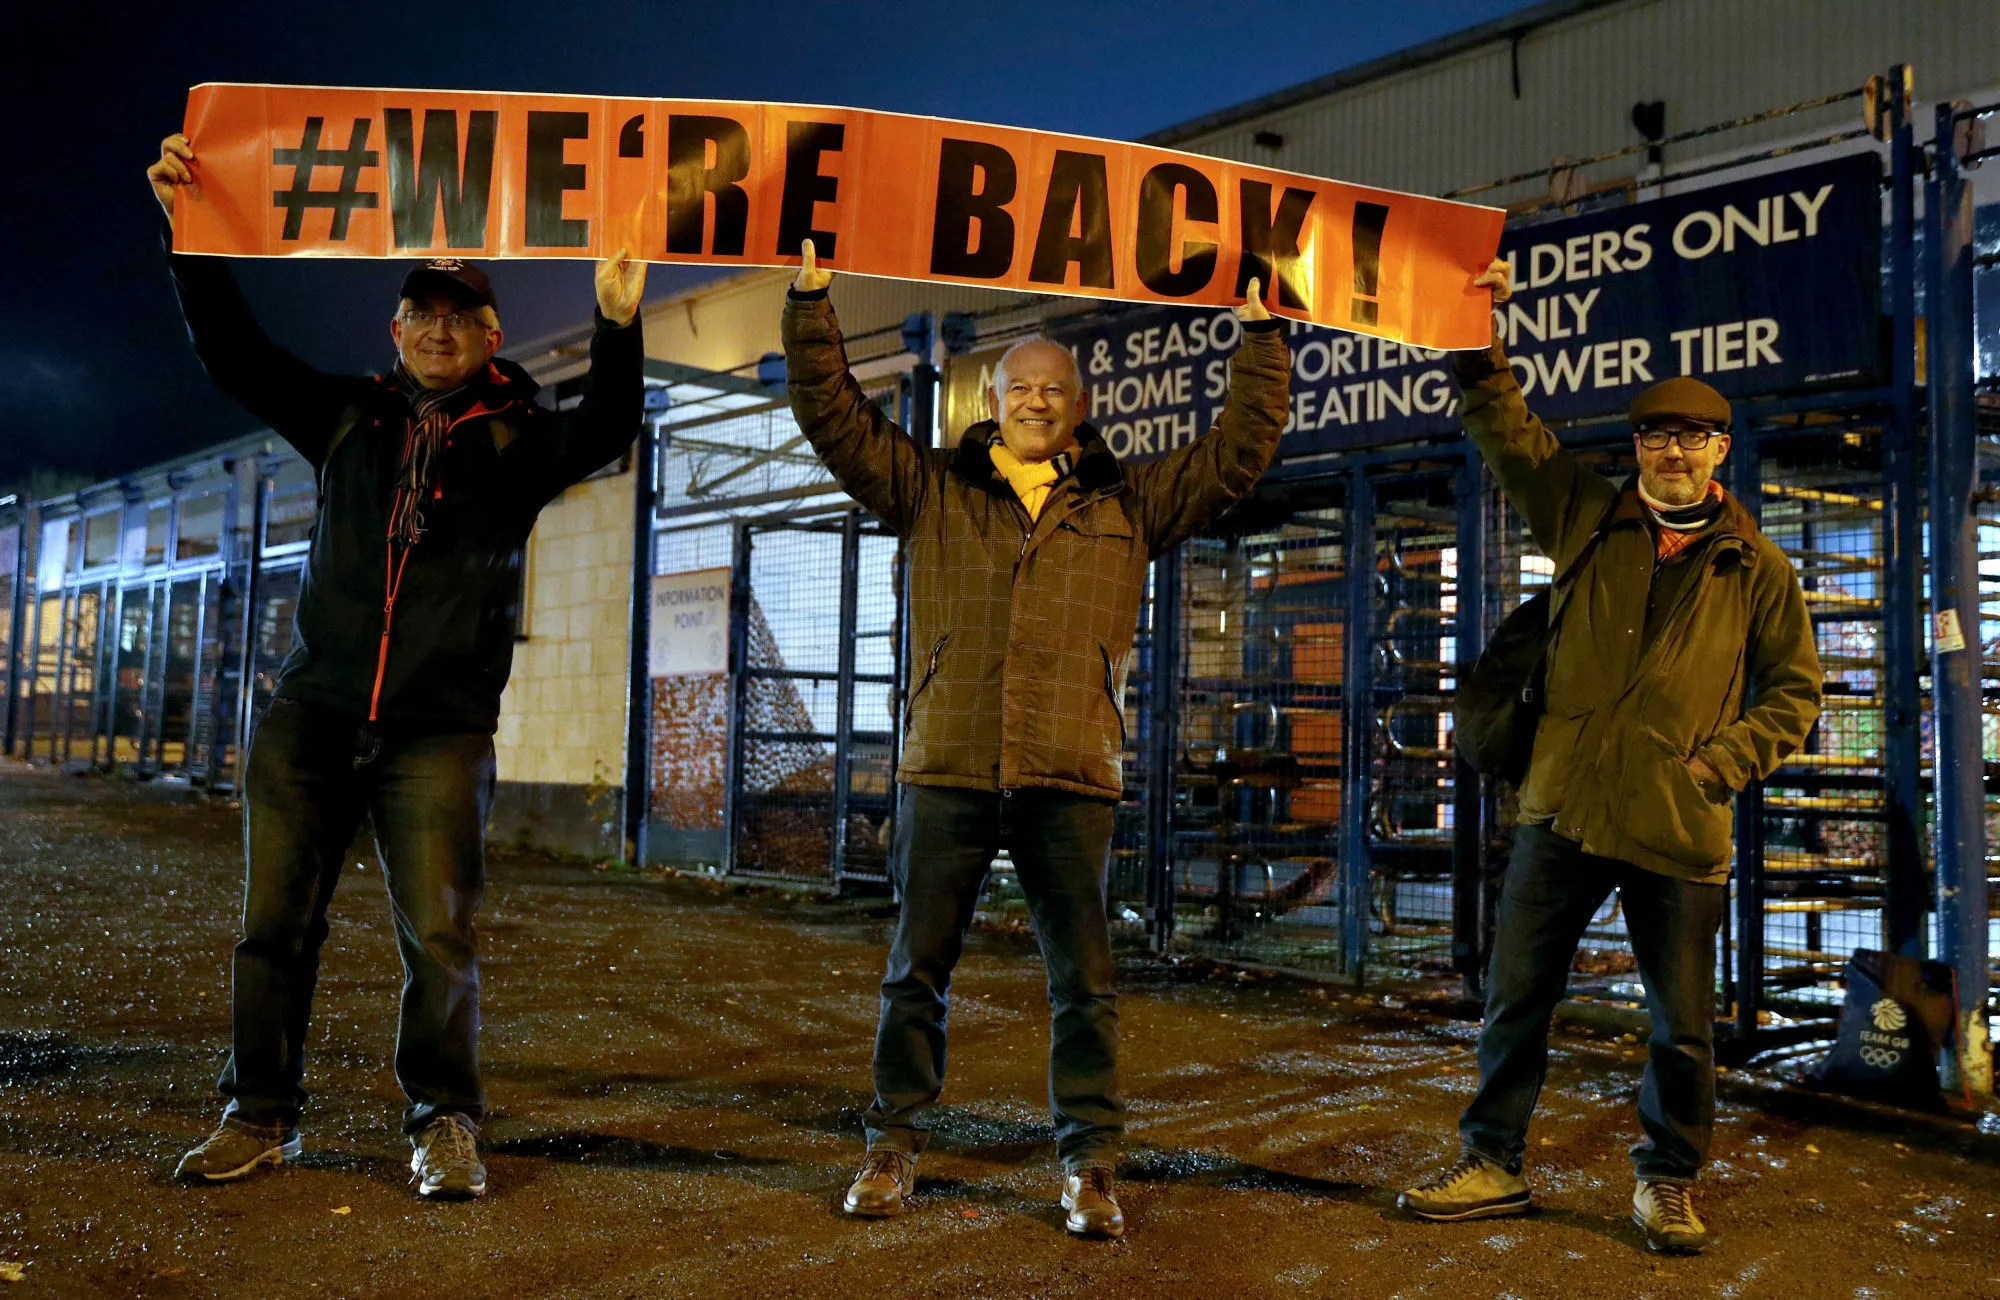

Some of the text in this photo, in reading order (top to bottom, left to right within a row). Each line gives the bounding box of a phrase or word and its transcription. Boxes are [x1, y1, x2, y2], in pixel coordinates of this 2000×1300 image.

[273, 108, 1389, 327] #WE'RE BACK!
[1089, 339, 1114, 376] &
[1125, 312, 1244, 369] SEASO
[1507, 223, 1652, 292] LDERS
[1672, 183, 1835, 260] ONLY
[1092, 366, 1192, 418] HOME
[1101, 411, 1196, 459] ORTH
[1508, 338, 1654, 397] OWER
[1670, 317, 1783, 376] TIER
[656, 584, 723, 608] INFORMATION
[674, 610, 704, 630] POINT
[1859, 1030, 1910, 1049] TEAM GB
